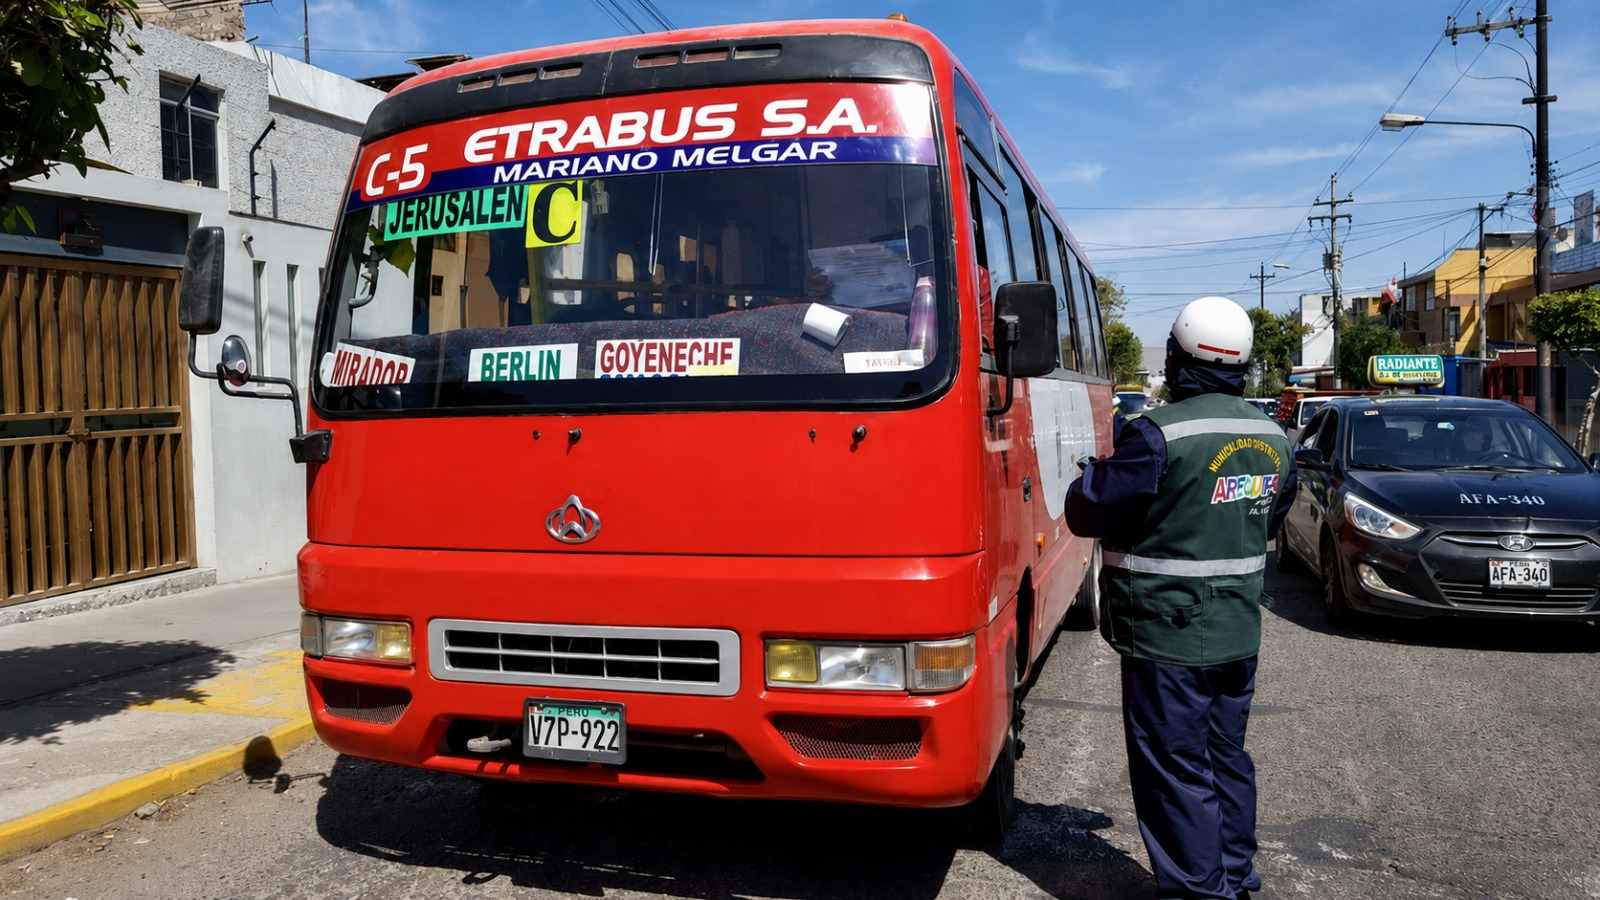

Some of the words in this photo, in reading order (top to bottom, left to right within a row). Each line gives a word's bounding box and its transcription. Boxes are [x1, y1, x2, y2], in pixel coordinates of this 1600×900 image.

[463, 102, 738, 163] ETRABUS
[761, 97, 878, 137] S.A.
[365, 143, 428, 197] C-5
[493, 151, 657, 183] MARIANO
[672, 141, 838, 167] MELGAR
[389, 185, 524, 235] JERUSALEN
[532, 180, 579, 243] C
[481, 349, 561, 381] BERLIN
[1377, 357, 1439, 370] RADIANTE
[1460, 493, 1545, 505] AFA-340
[1492, 566, 1547, 582] AFA-340
[530, 714, 619, 751] V7P-922
